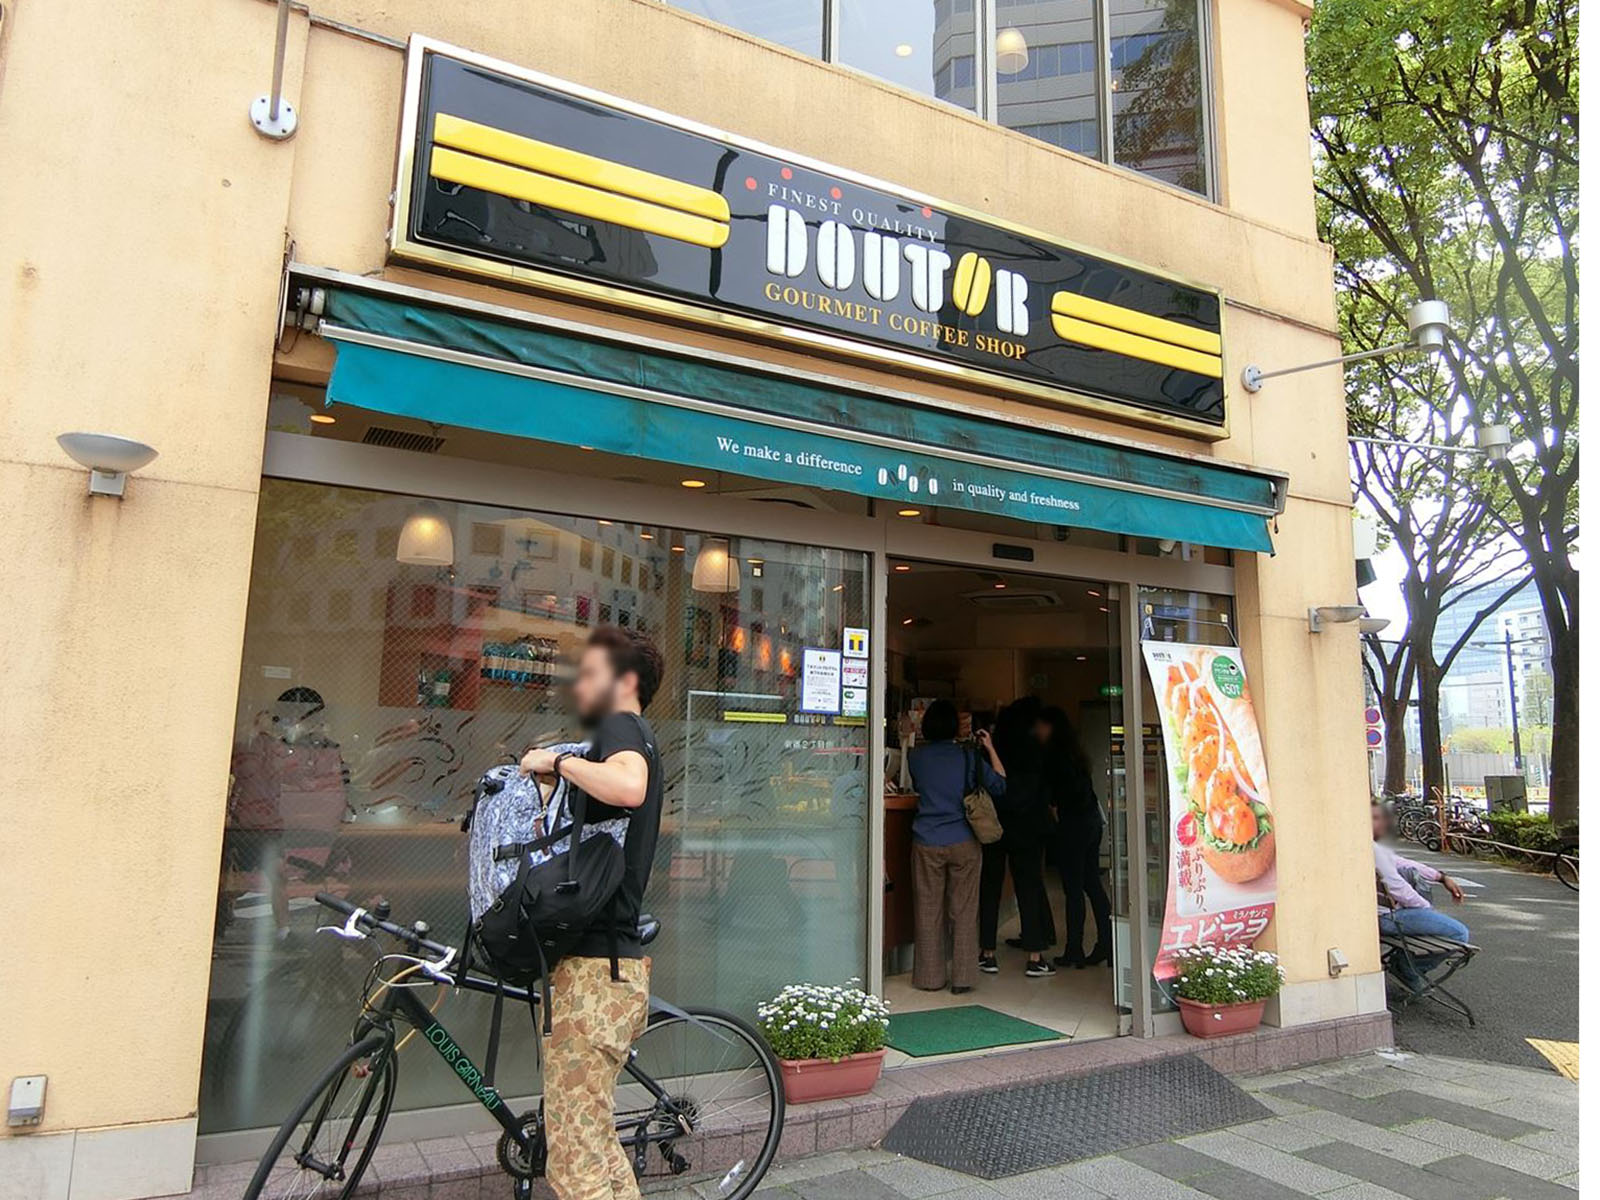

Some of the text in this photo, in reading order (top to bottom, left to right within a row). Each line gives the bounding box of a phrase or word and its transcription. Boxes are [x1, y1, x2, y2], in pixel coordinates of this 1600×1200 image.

[768, 183, 939, 243] FINEST QUALITY
[766, 204, 1030, 336] DOUTOR
[764, 282, 1027, 360] GOURMET COFFEE SHOP
[716, 437, 1080, 511] We make a difference in quality and freshness
[1163, 913, 1269, 951] エビマヨ
[1233, 910, 1268, 919] ミラノサンド
[425, 1022, 501, 1111] LOUIS GARNEAU
